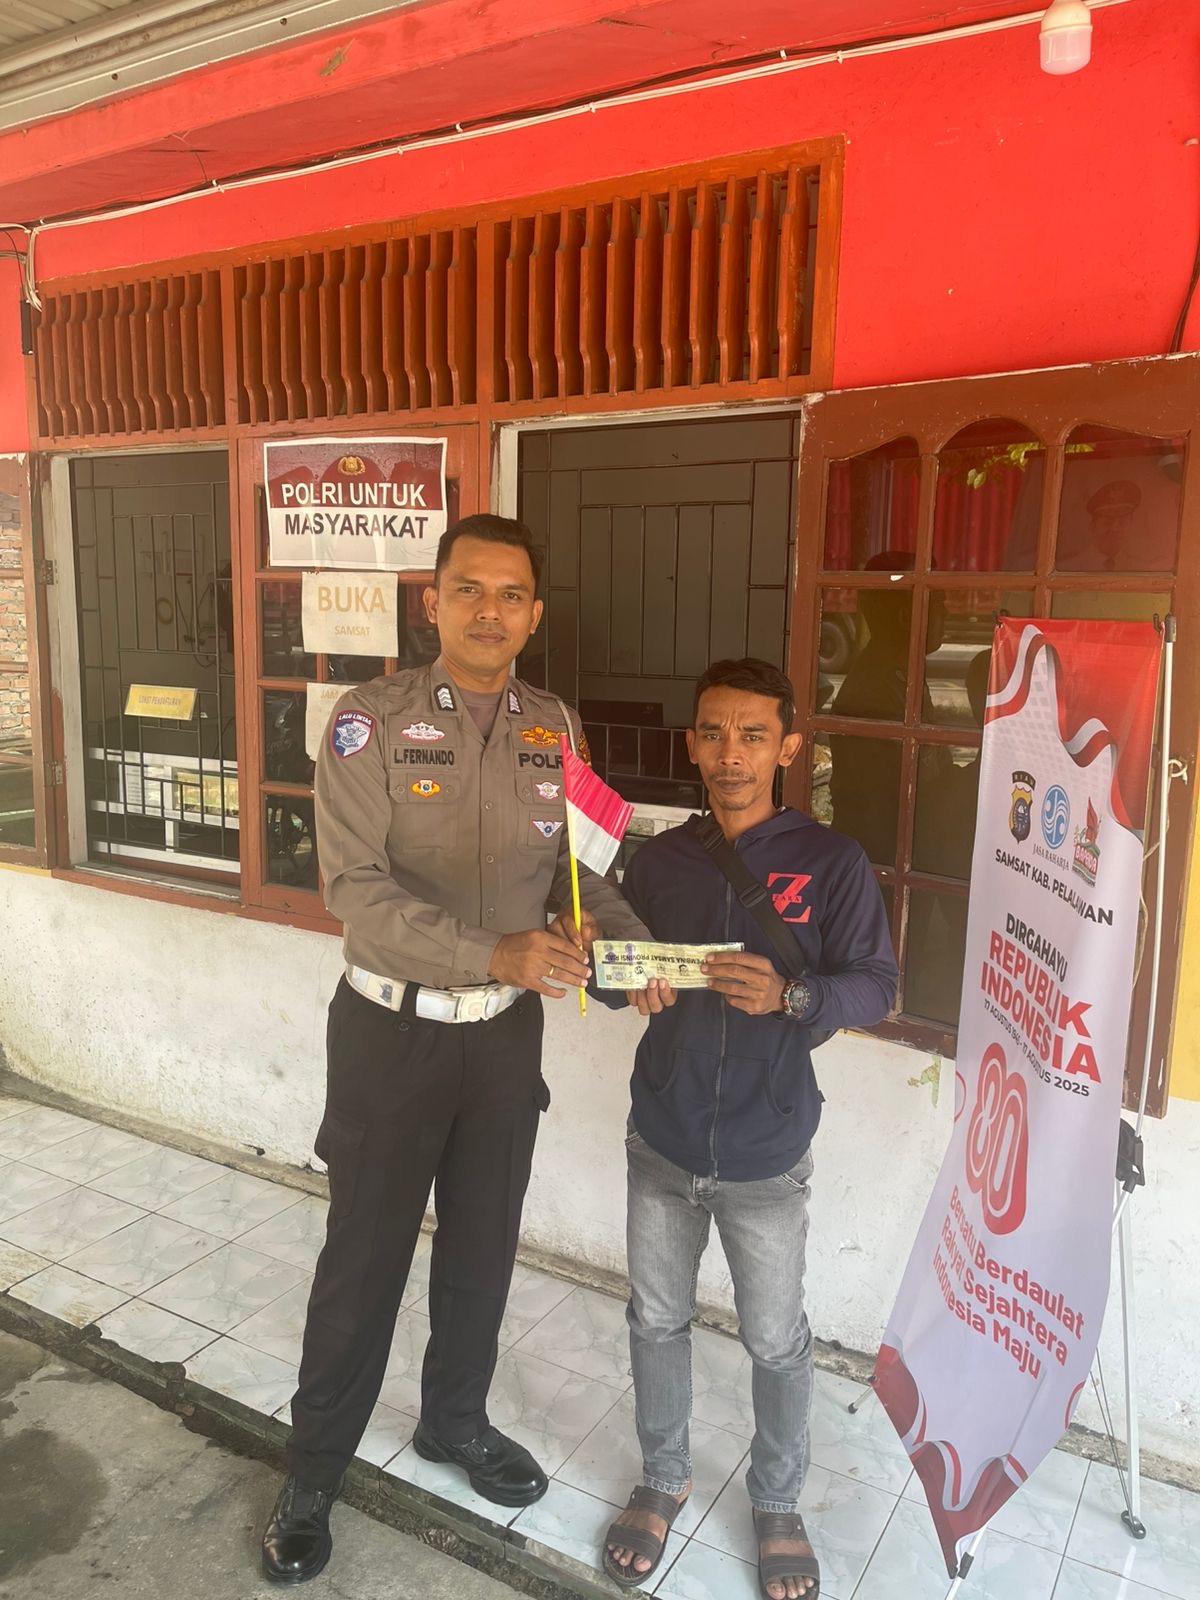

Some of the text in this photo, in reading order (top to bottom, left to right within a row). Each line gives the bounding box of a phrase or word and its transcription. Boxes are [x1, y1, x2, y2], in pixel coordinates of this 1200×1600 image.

[282, 482, 427, 507] POLRI UNTUK
[285, 512, 428, 539] MASYARAKAT
[318, 586, 386, 613] BUKA
[335, 625, 371, 638] SAMSAT
[394, 748, 455, 765] L.FERNANDO
[995, 848, 1031, 877] SAMSAT
[1031, 866, 1051, 891] KAB.
[1052, 879, 1113, 926] PELALAWAN
[1033, 844, 1070, 871] JASA RAHARJA
[1006, 912, 1068, 983] DIRGAHAYU
[990, 930, 1092, 1038] REPUBLIK
[980, 961, 1101, 1083] INDONESIA
[1026, 1049, 1051, 1083] AGUSTUS
[1054, 1076, 1090, 1097] 2025
[966, 1042, 1028, 1236] 80
[941, 1215, 1068, 1367] Rakyat Sejahtera
[950, 1184, 1084, 1340] Bersatu Berdaulat
[933, 1244, 1042, 1380] Indonesia Maju
